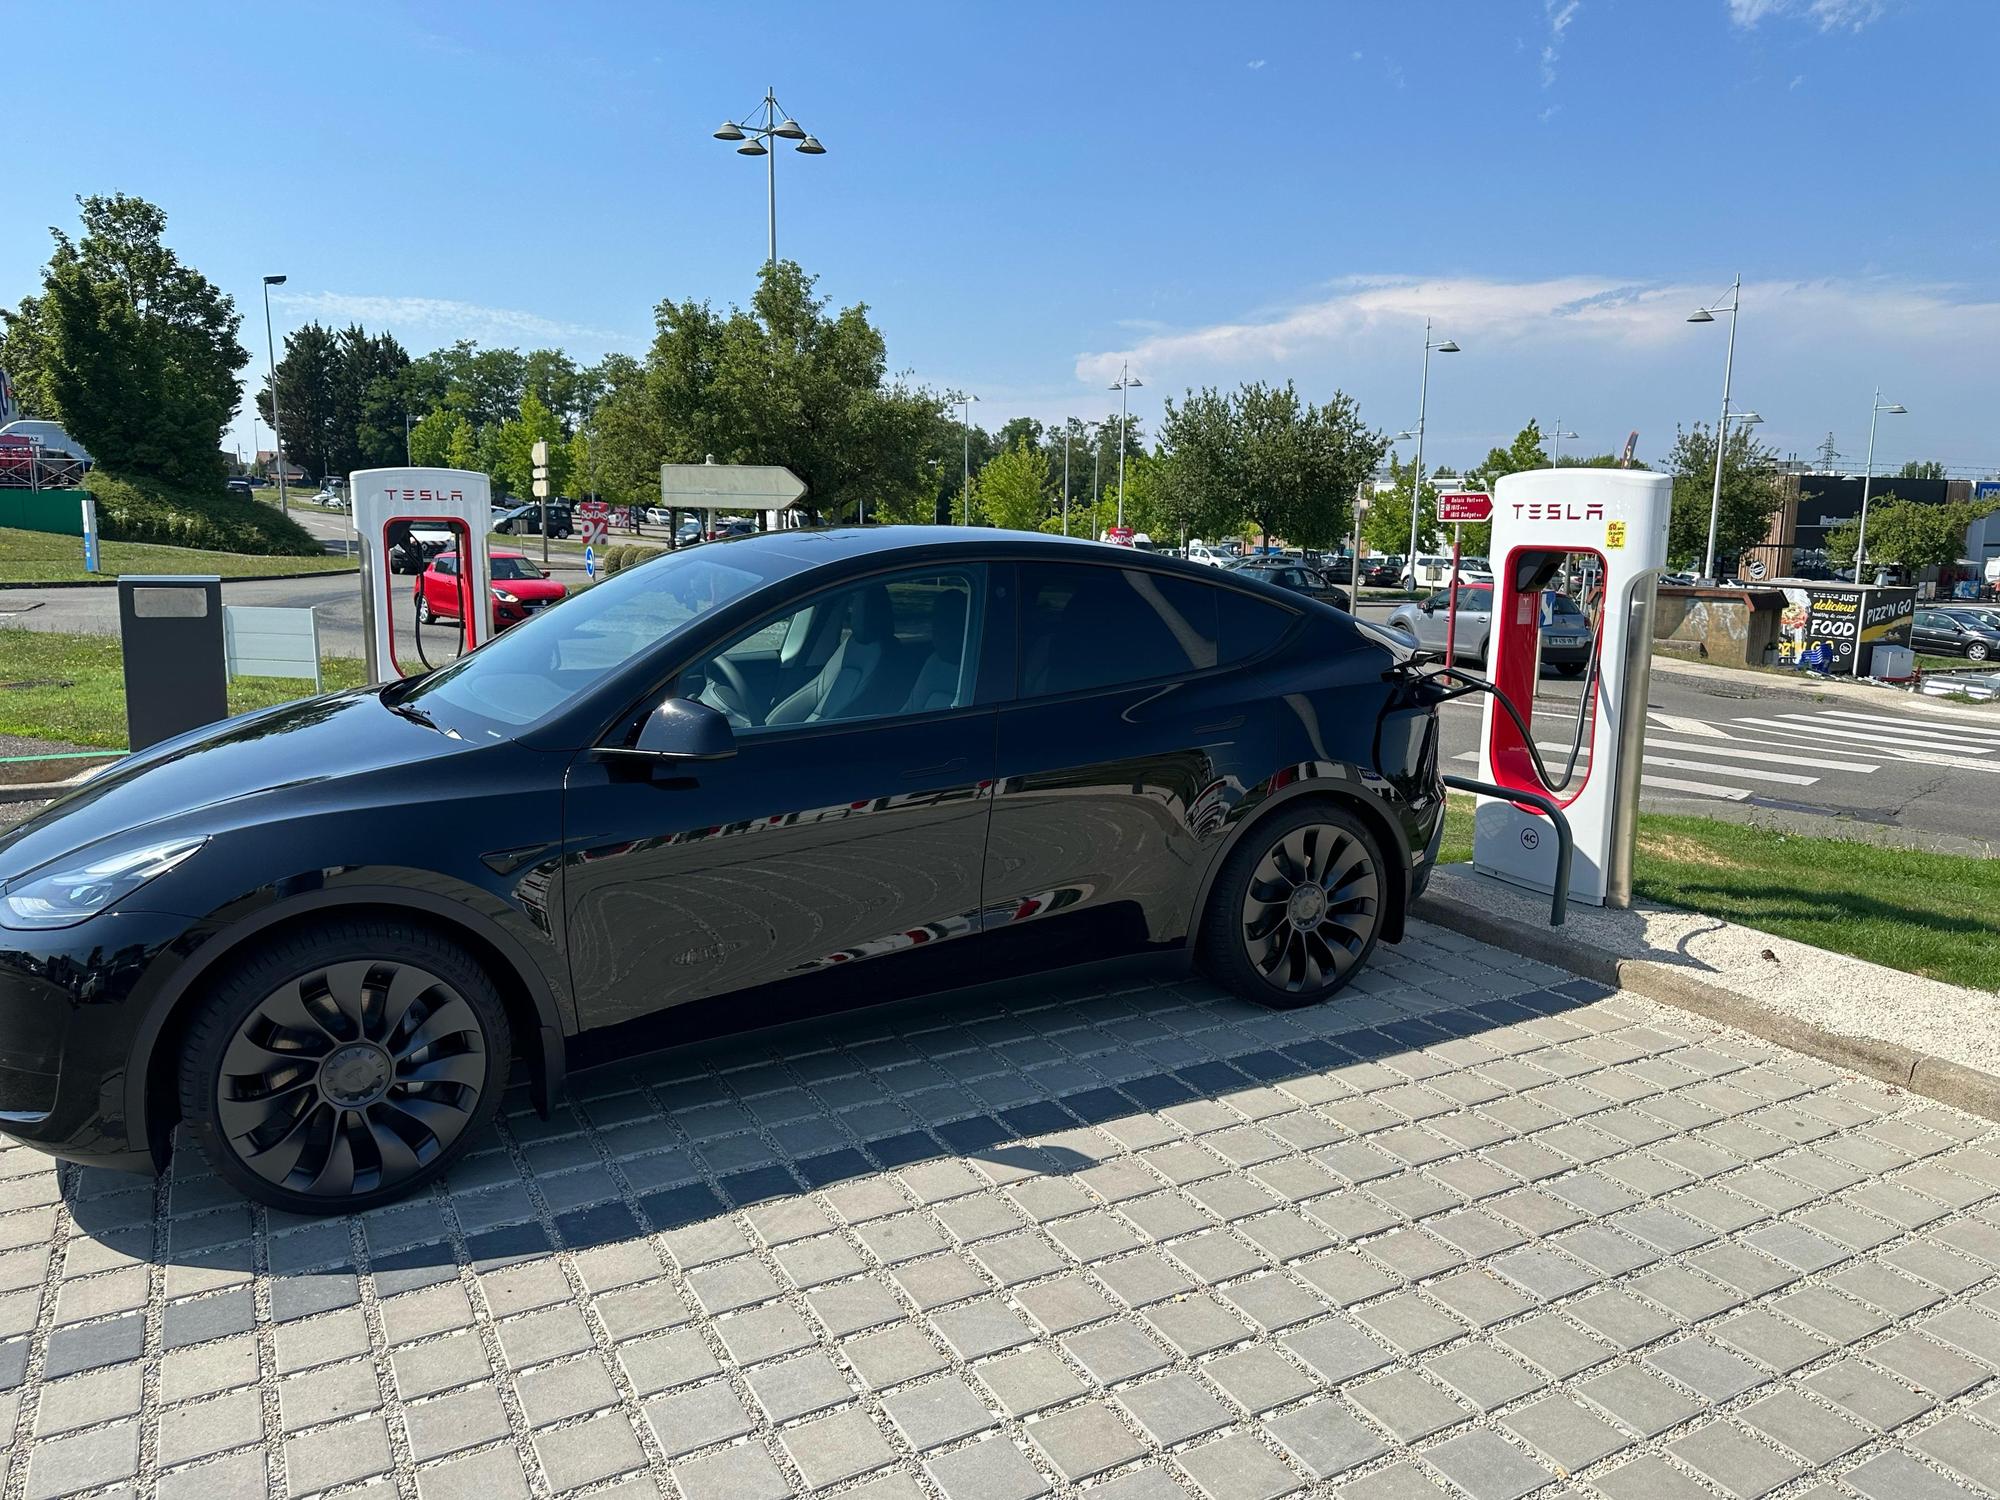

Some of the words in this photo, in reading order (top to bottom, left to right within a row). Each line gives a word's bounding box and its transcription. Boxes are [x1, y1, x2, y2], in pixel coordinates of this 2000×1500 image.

[384, 489, 463, 501] TESLA
[1511, 503, 1604, 521] TESLA
[1813, 598, 1858, 613] delicious
[1839, 594, 1859, 602] JUST
[1897, 599, 1912, 616] GO
[1810, 619, 1855, 637] FOOD
[1523, 833, 1536, 844] 4C
